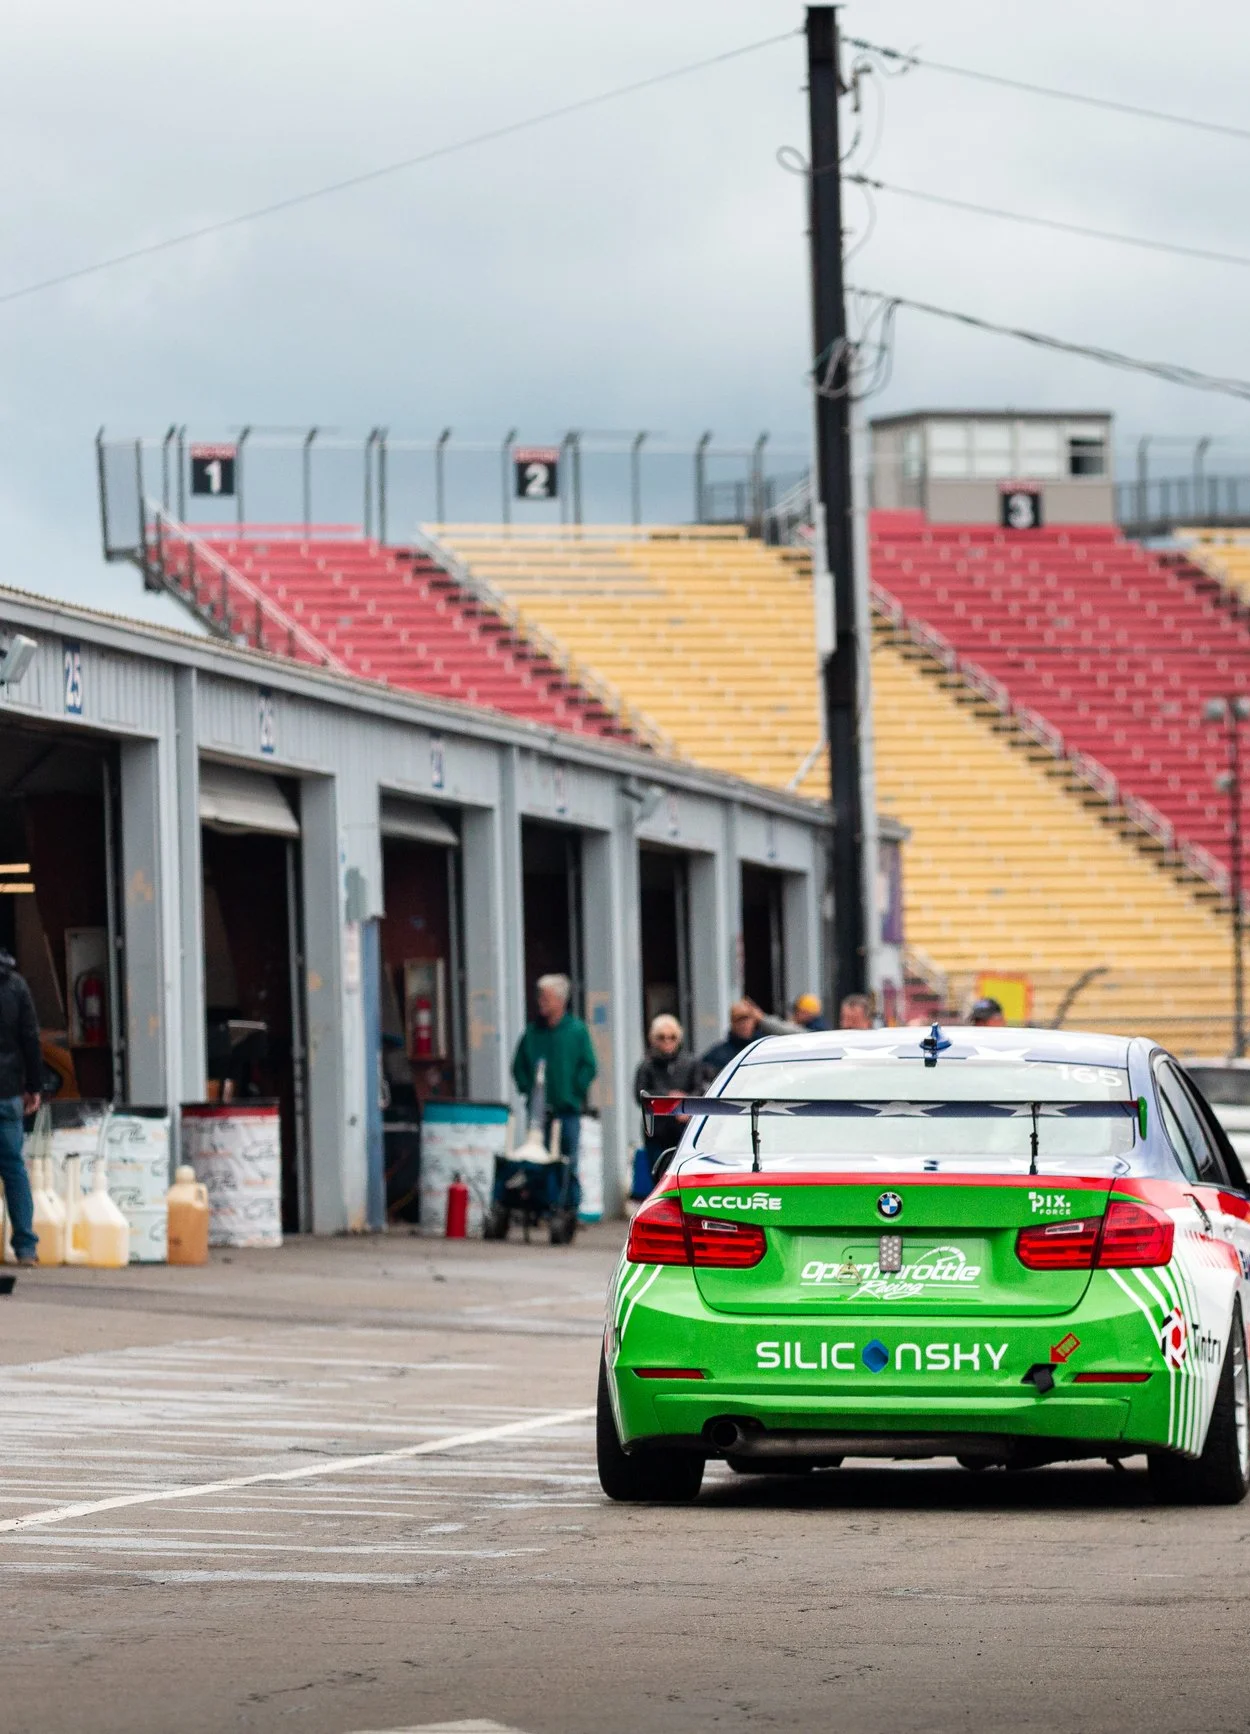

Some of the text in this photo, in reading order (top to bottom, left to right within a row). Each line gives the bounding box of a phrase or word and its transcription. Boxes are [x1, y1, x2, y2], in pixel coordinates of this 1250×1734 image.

[203, 459, 222, 493] 1
[524, 462, 550, 496] 2
[1008, 494, 1035, 529] 3
[1056, 1064, 1123, 1087] 165
[1039, 1208, 1072, 1216] FORCE
[847, 1279, 925, 1300] Racing
